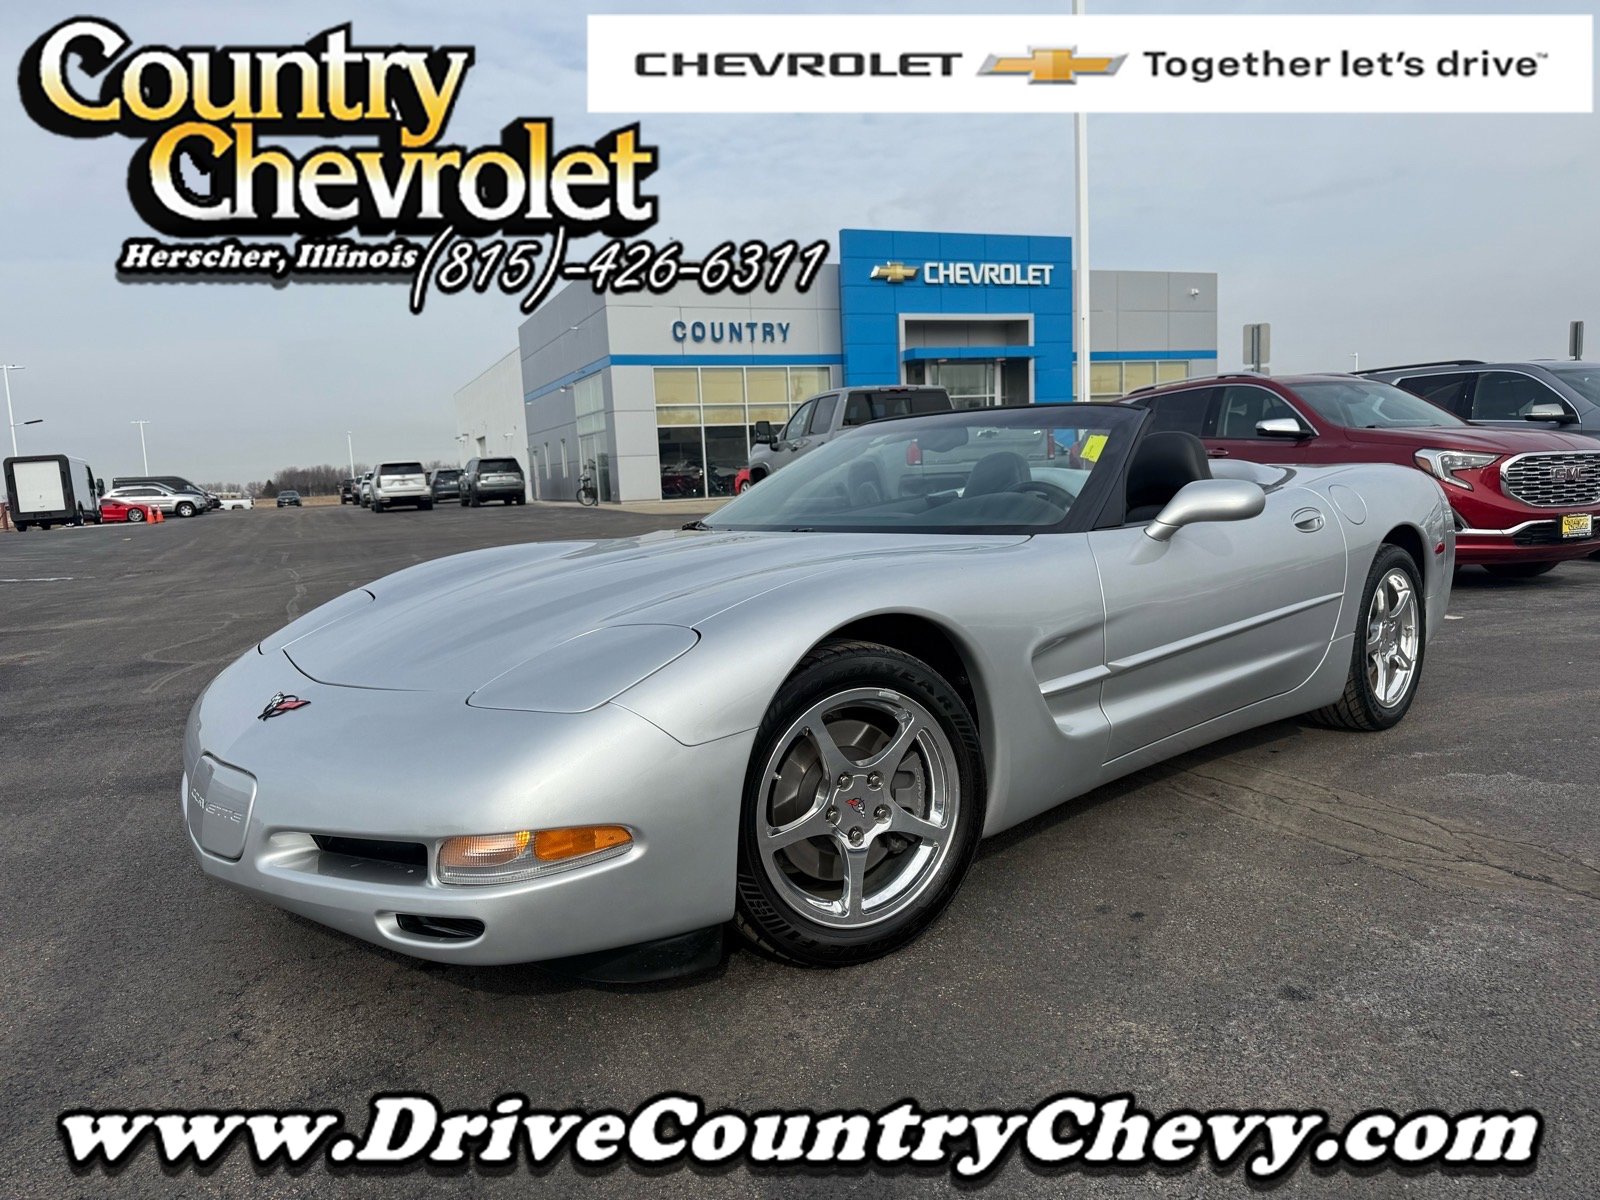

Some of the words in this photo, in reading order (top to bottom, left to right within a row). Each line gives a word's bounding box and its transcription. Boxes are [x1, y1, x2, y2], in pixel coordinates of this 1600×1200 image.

[923, 261, 1055, 286] CHEVROLET
[672, 320, 790, 343] COUNTRY
[1548, 465, 1589, 482] GMC
